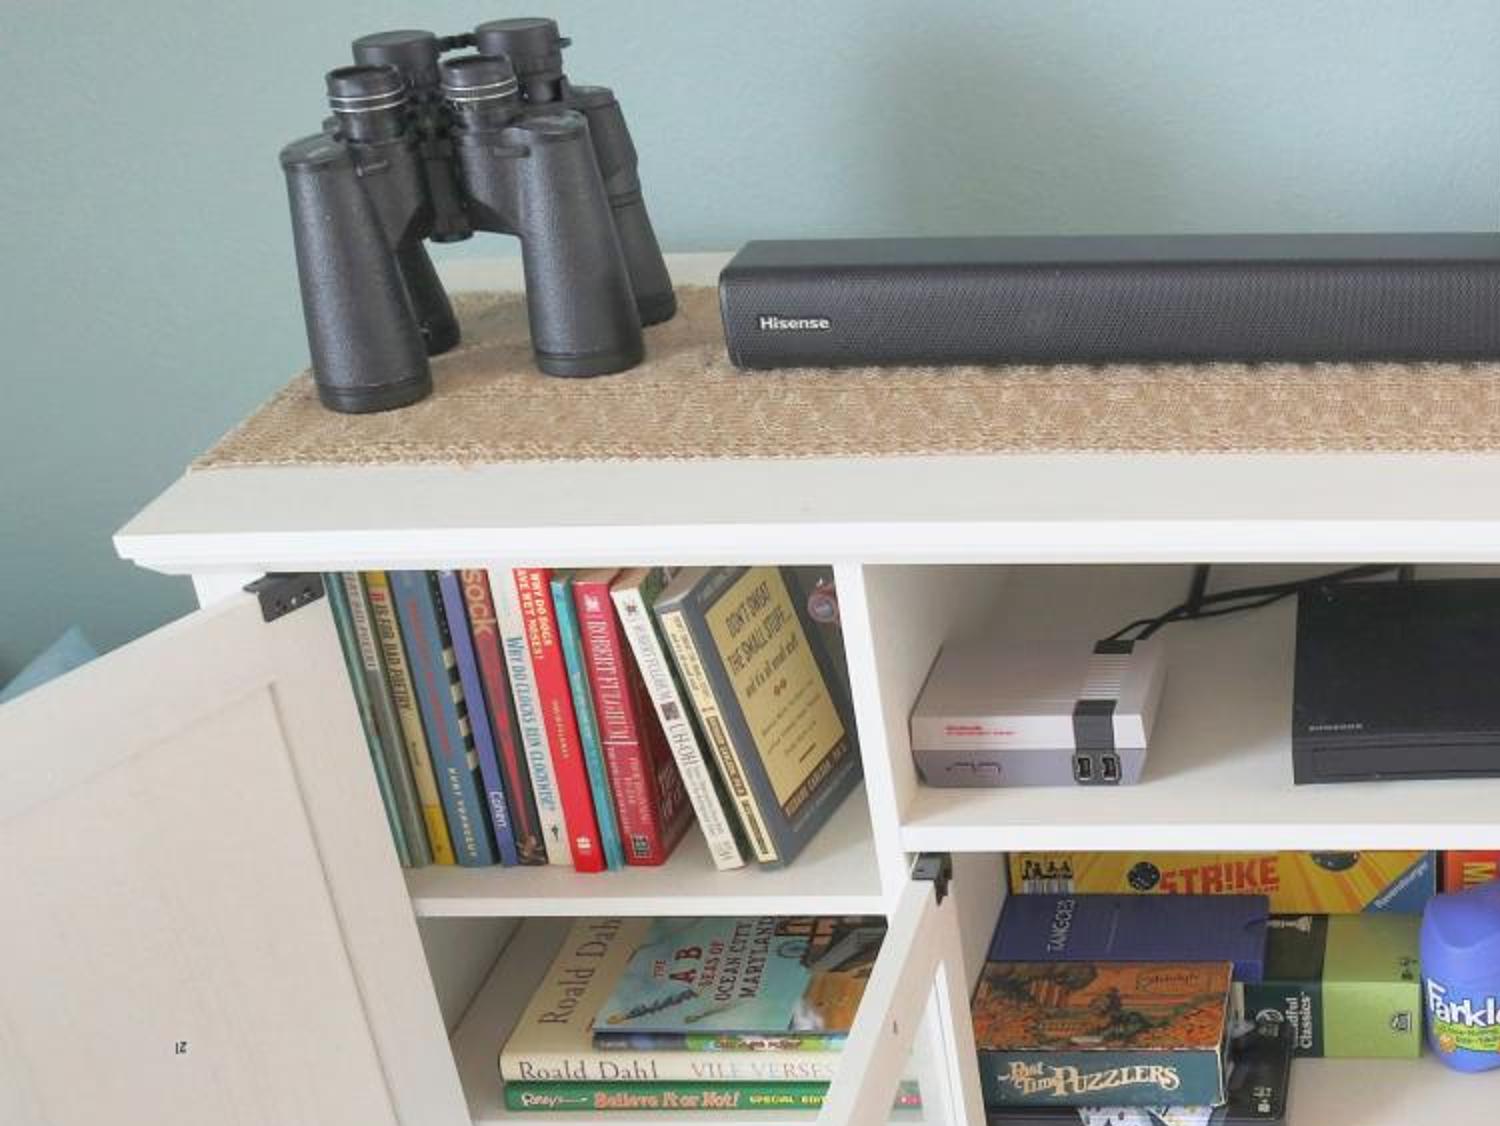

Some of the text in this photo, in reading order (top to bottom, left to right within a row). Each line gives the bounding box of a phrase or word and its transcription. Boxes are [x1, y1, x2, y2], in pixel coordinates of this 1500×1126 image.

[759, 316, 831, 331] Hisense
[538, 959, 594, 1025] Roald
[518, 1059, 659, 1080] Roald Dahl
[1051, 1065, 1180, 1096] PUZZLERS
